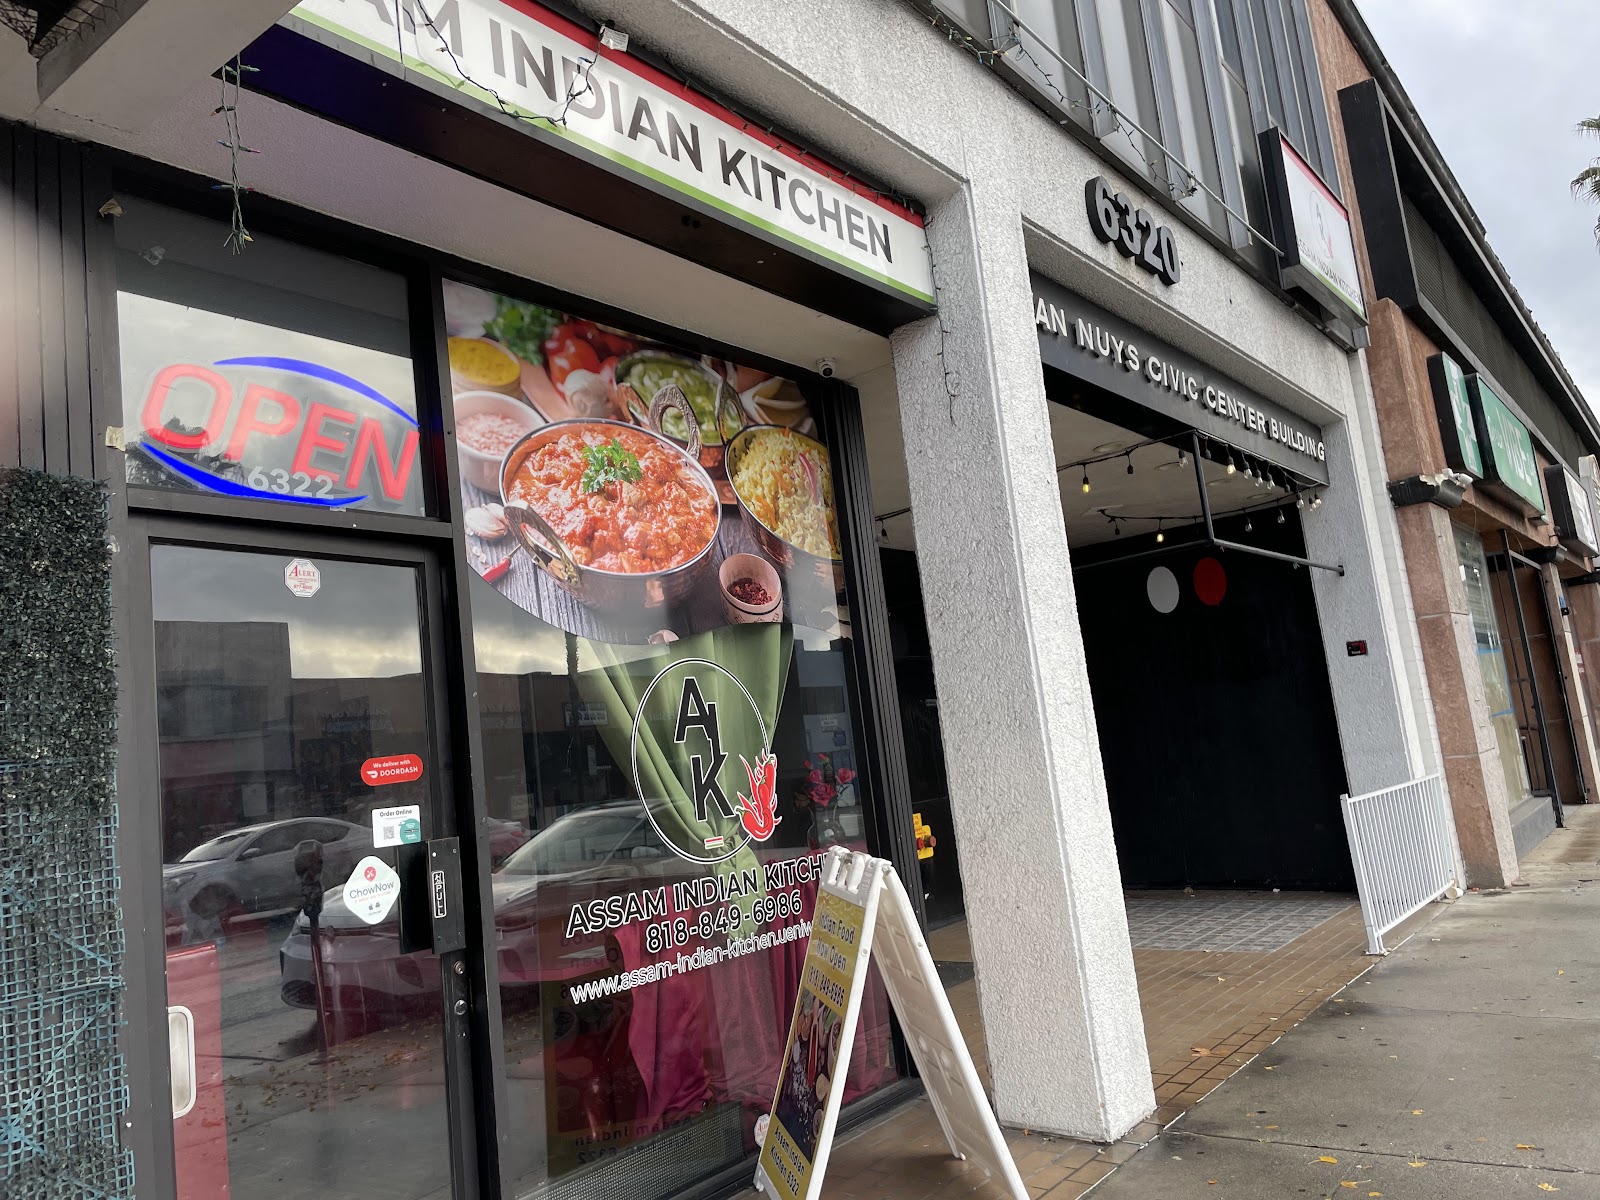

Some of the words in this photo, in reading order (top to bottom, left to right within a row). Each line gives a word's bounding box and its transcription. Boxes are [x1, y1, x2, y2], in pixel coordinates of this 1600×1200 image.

[489, 18, 703, 173] INDIAN
[718, 137, 893, 264] KITCHEN
[1086, 175, 1181, 286] 6320
[1076, 317, 1140, 371] NUYS
[1146, 355, 1199, 401] CIVIC
[1205, 385, 1267, 434] CENTER
[1270, 417, 1326, 462] BUILDING
[140, 363, 421, 501] OPEN
[247, 466, 335, 500] 6322
[288, 564, 316, 578] ALERT
[380, 766, 418, 777] DOORDASH
[380, 810, 395, 818] Order
[395, 808, 413, 816] Online
[349, 880, 395, 899] ChowNow
[435, 884, 444, 917] PULL
[566, 886, 668, 938] ASSAM
[672, 868, 759, 913] INDIAN
[763, 850, 830, 892] KITCH
[646, 889, 803, 953] 818-849-6986
[837, 919, 856, 945] Food
[816, 937, 829, 960] Now
[829, 944, 847, 972] Open
[774, 1126, 790, 1154] Assam
[790, 1147, 805, 1177] Indian
